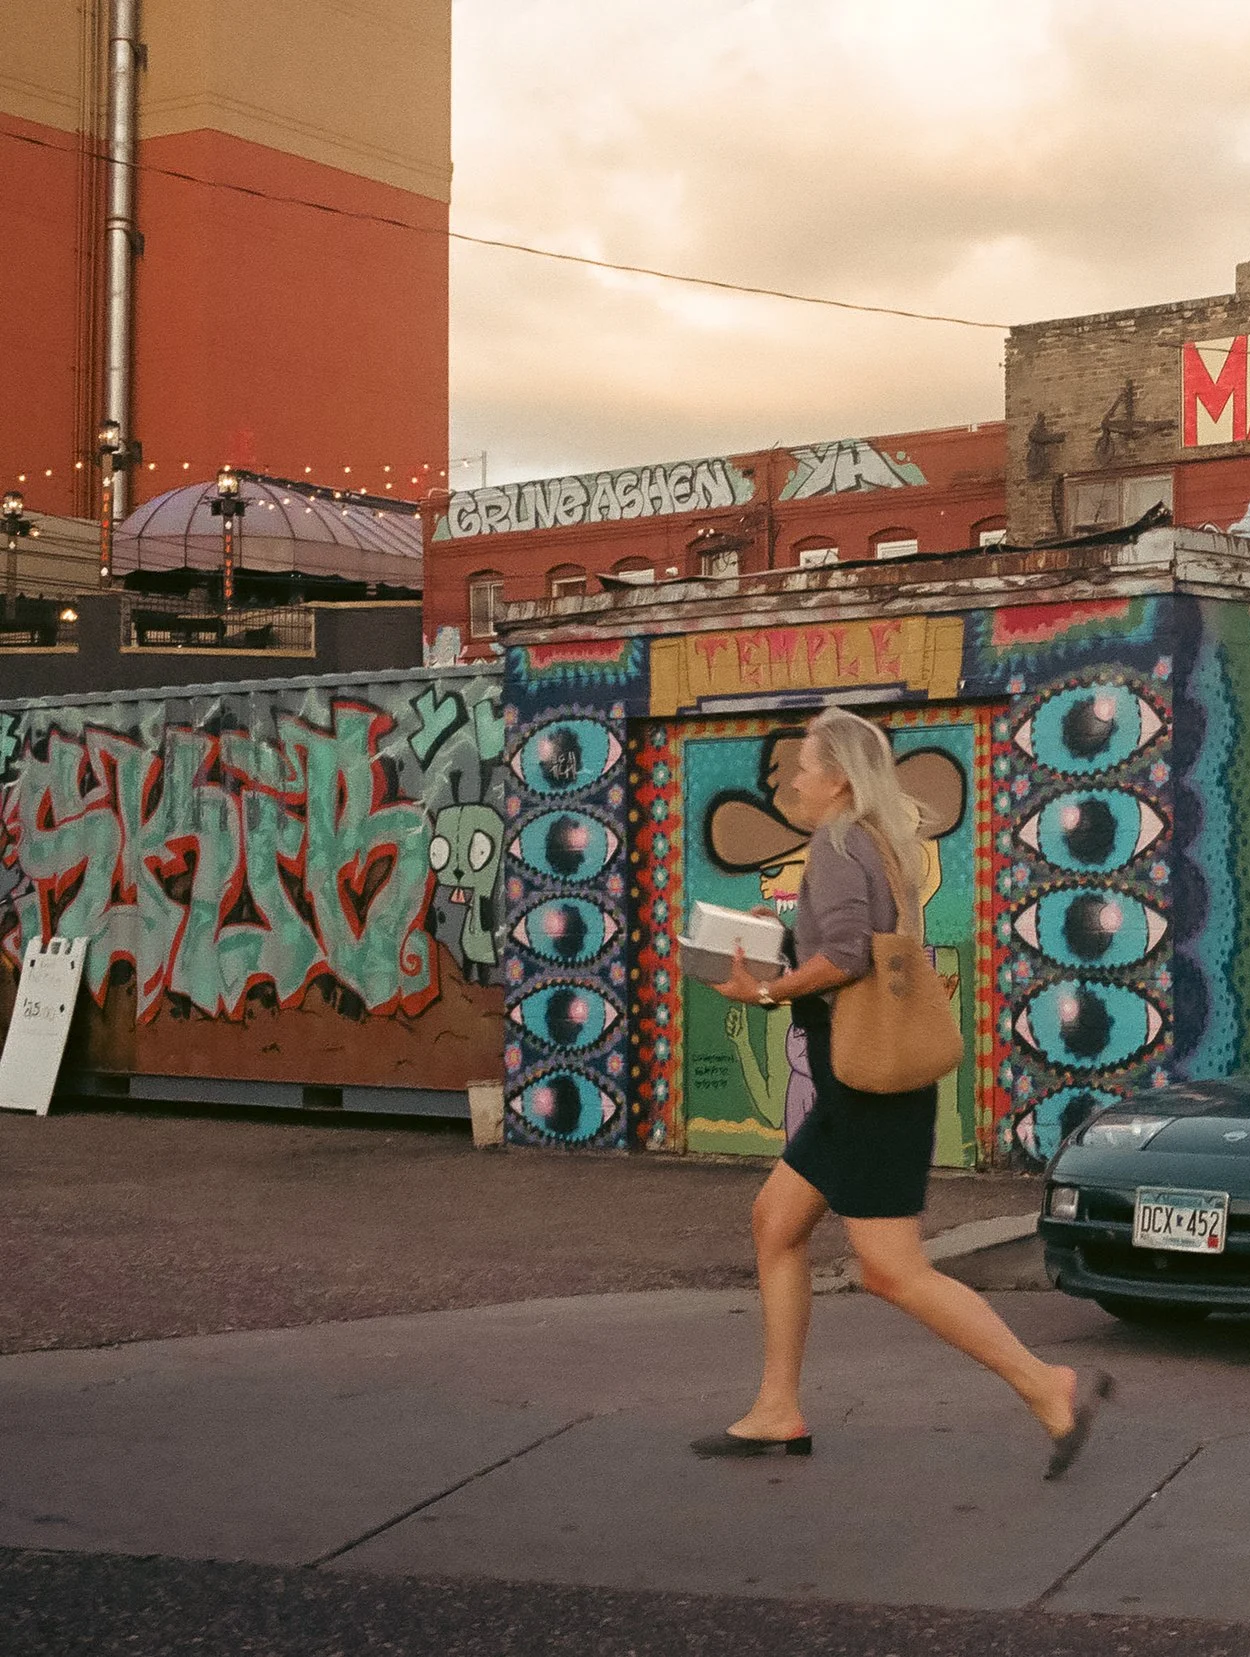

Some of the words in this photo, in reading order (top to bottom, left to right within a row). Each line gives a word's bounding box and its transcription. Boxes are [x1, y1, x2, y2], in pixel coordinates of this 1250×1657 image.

[694, 618, 902, 687] TEMPLE
[1140, 1205, 1175, 1235] DCX
[1186, 1209, 1220, 1238] 452
